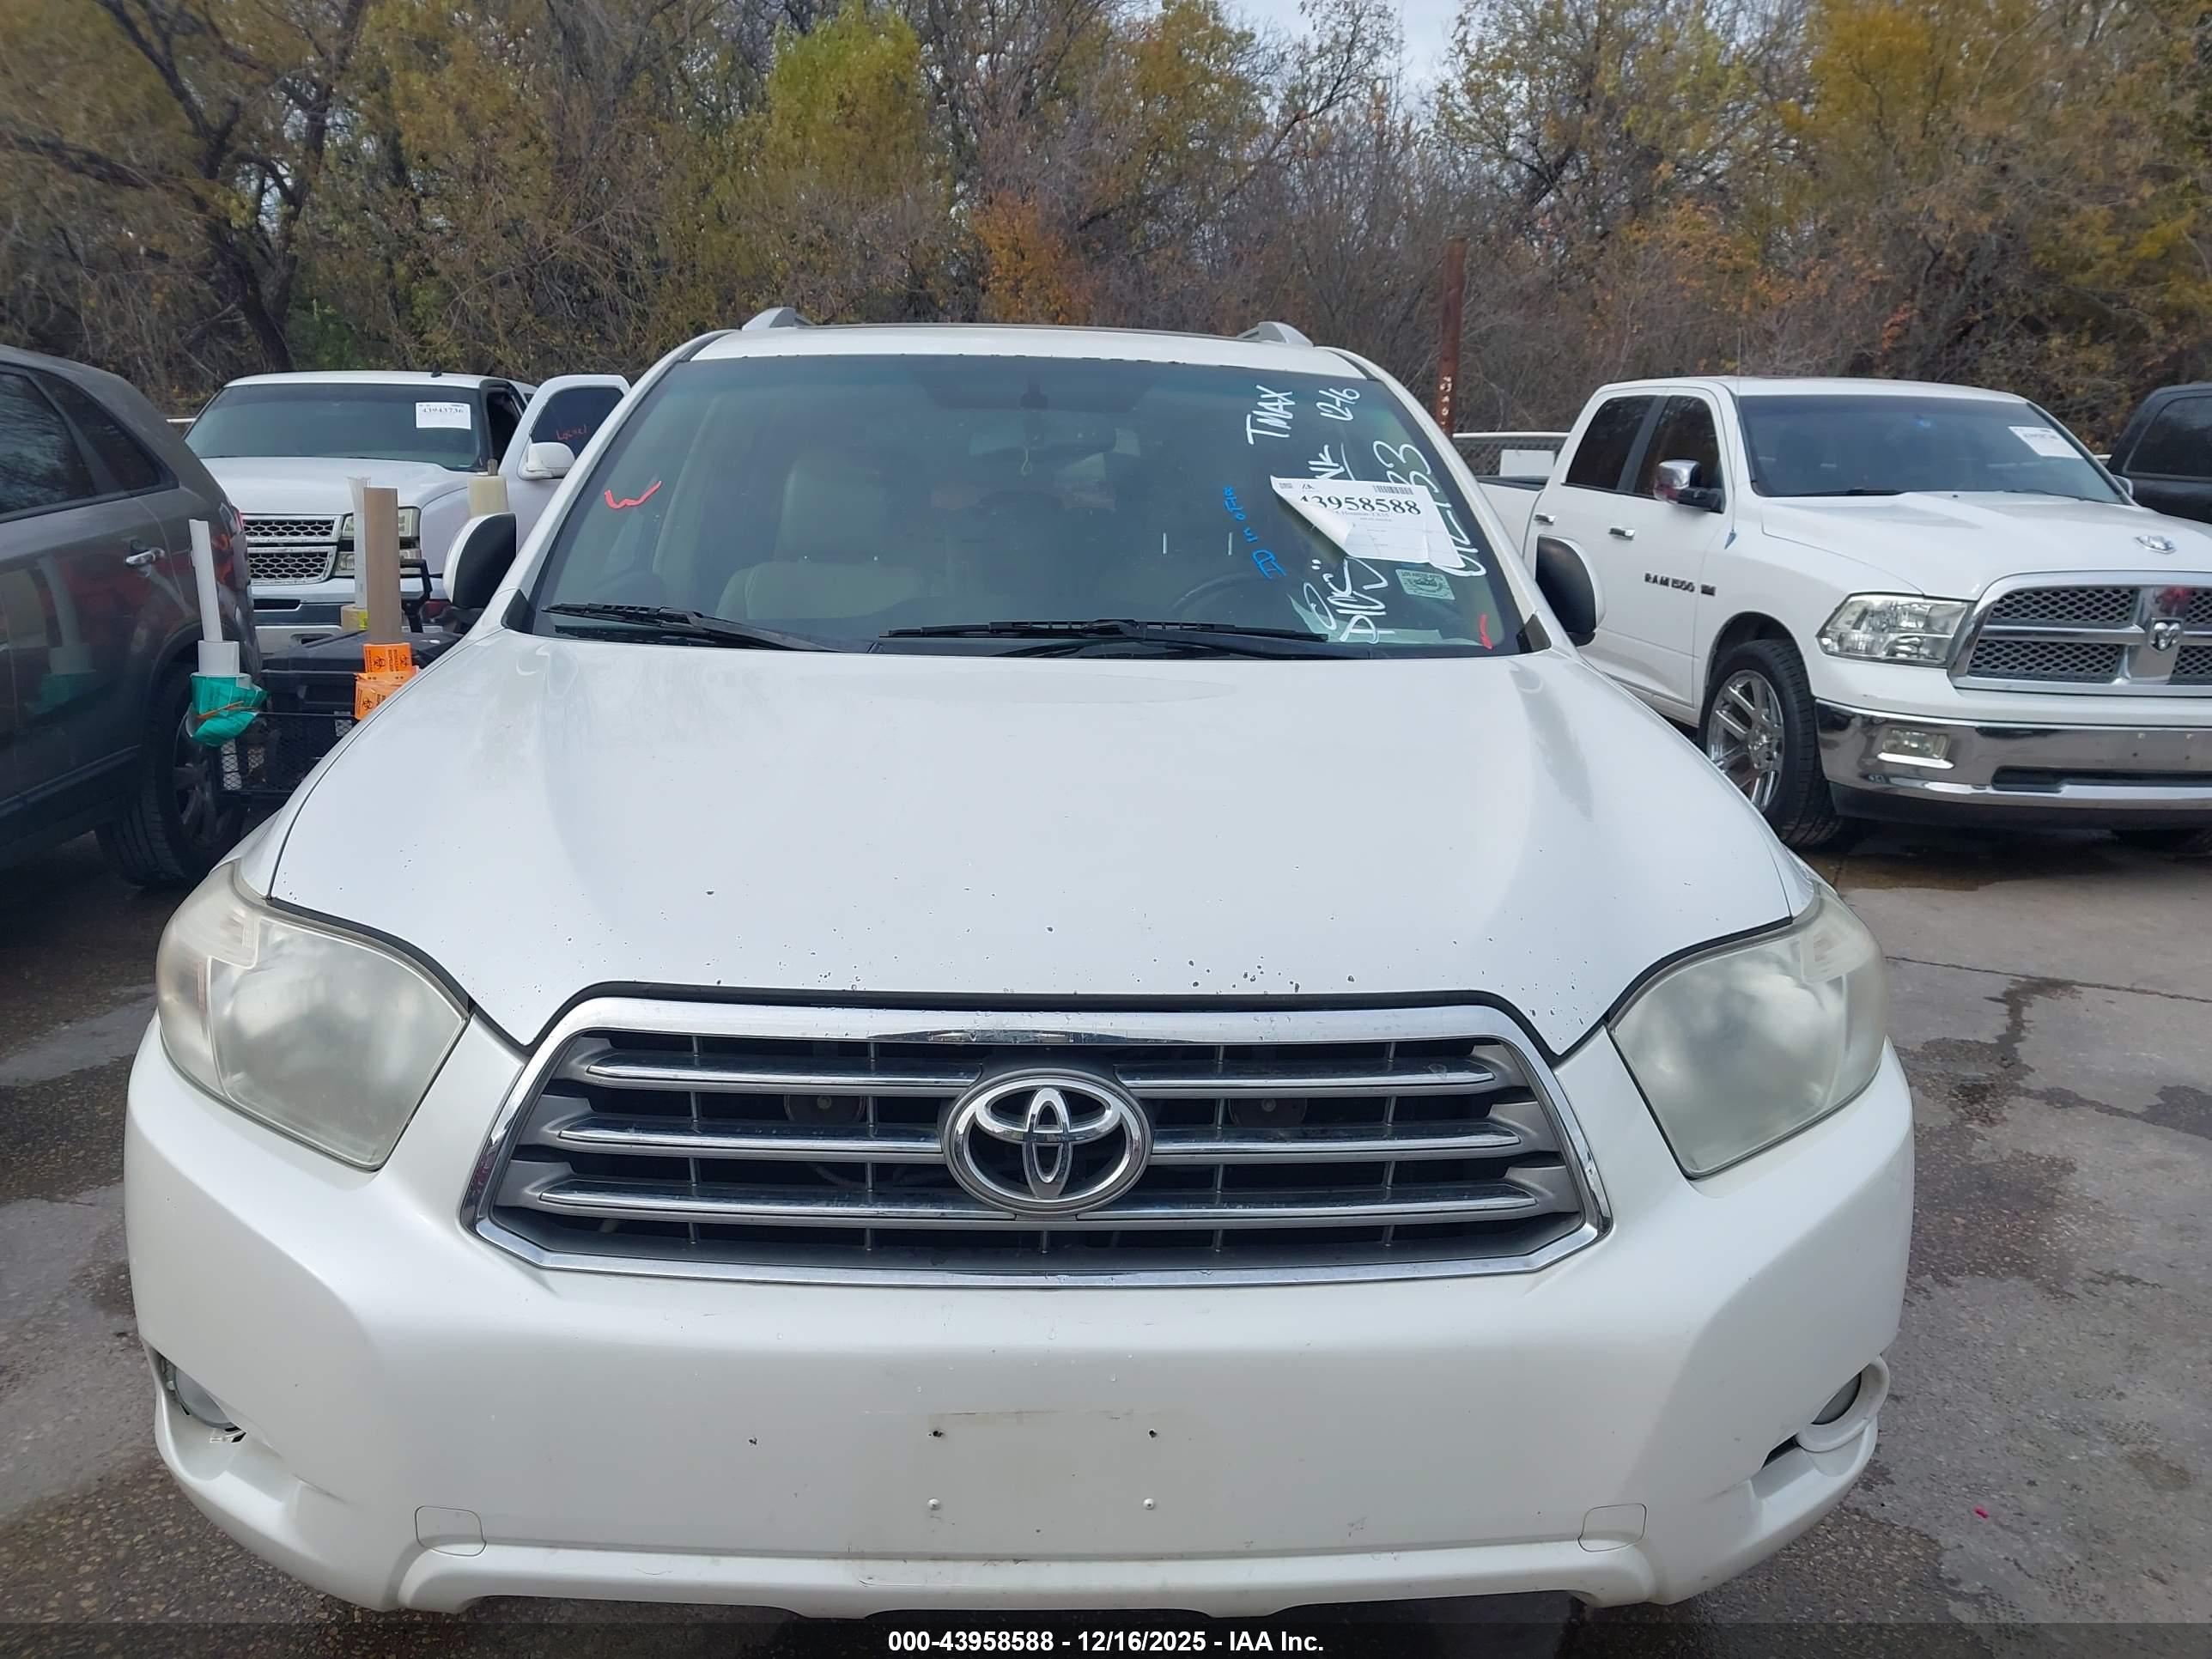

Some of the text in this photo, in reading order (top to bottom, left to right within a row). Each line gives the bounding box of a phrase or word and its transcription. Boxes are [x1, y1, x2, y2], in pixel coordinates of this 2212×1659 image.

[1246, 385, 1296, 446] TMAX
[1644, 572, 1670, 587] RAM
[1671, 577, 1695, 592] 1500
